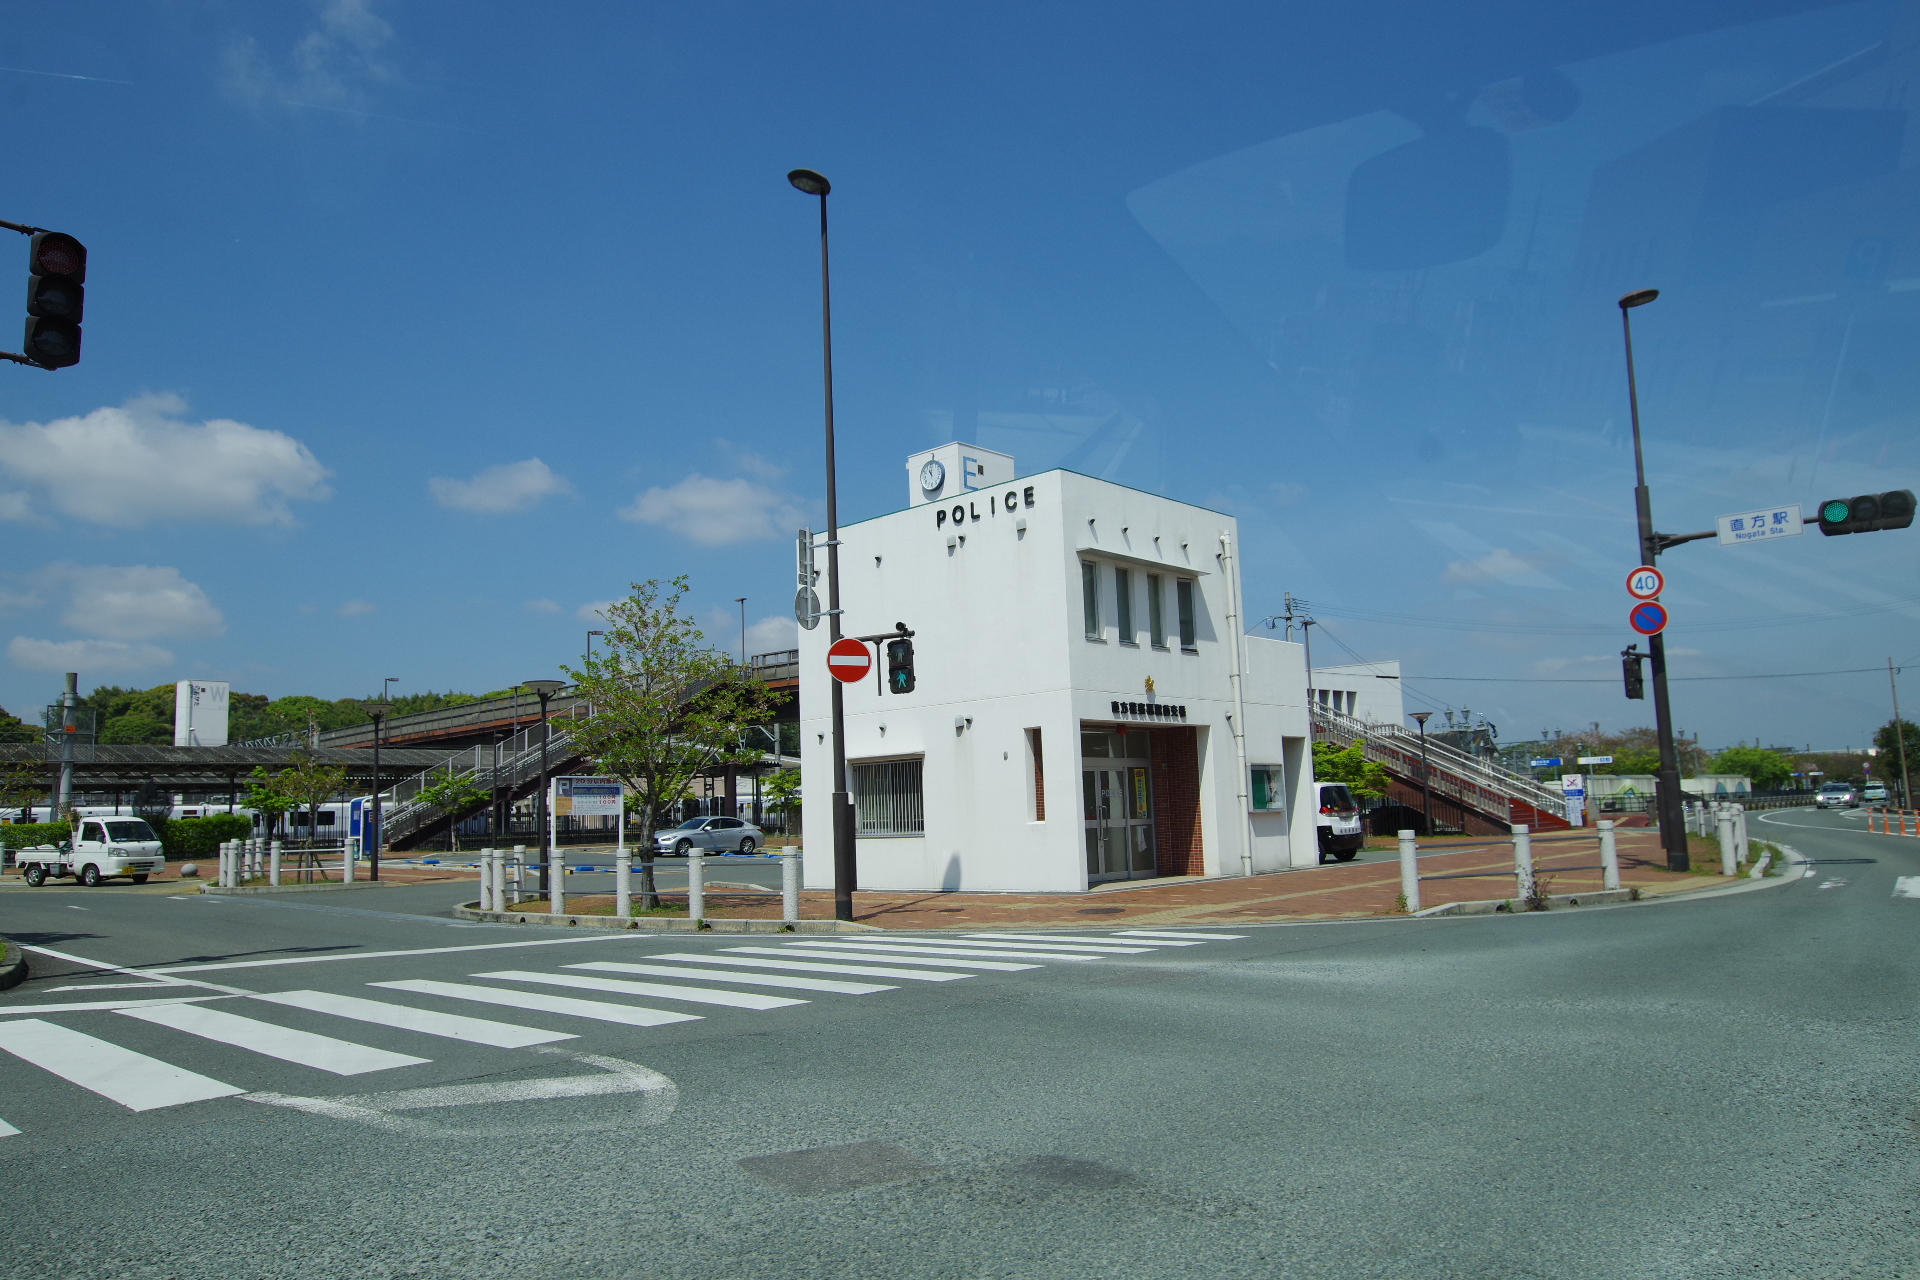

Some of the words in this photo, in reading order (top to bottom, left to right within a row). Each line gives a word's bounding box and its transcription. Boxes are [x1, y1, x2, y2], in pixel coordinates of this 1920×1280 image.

[963, 456, 978, 491] E
[936, 486, 1035, 528] POLICE
[1730, 511, 1789, 532] 直方駅
[1735, 529, 1766, 540] Nogata
[1770, 526, 1786, 534] Sta.
[1634, 575, 1656, 591] 40
[210, 686, 226, 702] W
[1101, 789, 1123, 797] POLICE
